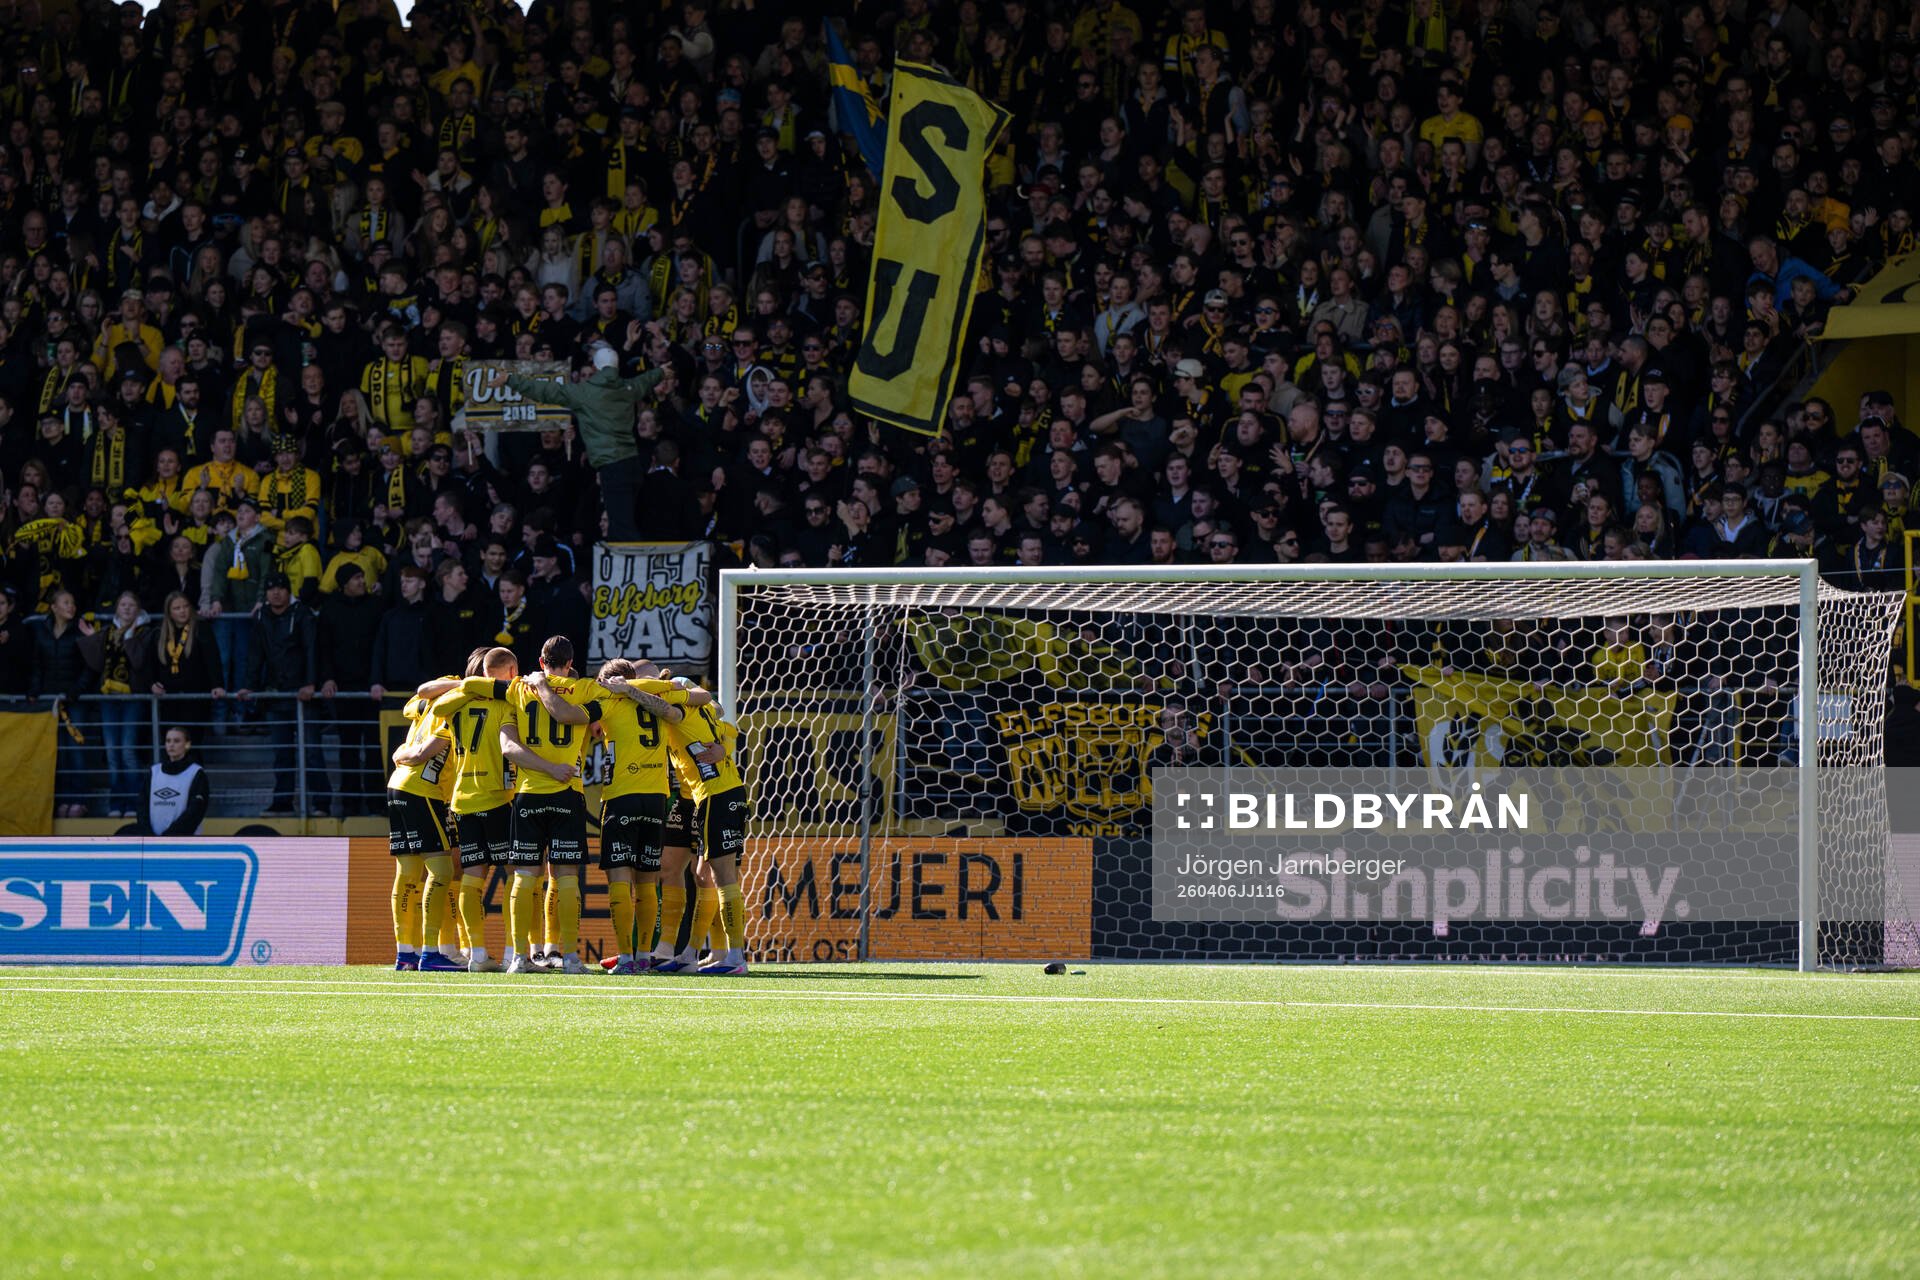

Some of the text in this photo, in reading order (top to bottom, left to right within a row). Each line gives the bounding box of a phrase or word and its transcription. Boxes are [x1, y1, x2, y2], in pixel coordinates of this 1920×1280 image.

[503, 404, 537, 421] 2018
[593, 580, 701, 626] Elfsborg
[452, 707, 489, 756] 17
[524, 700, 573, 748] 10
[635, 703, 660, 749] 9
[0, 877, 218, 931] SEN
[763, 853, 1023, 920] MEJERI
[1276, 846, 1691, 937] Simplicity.
